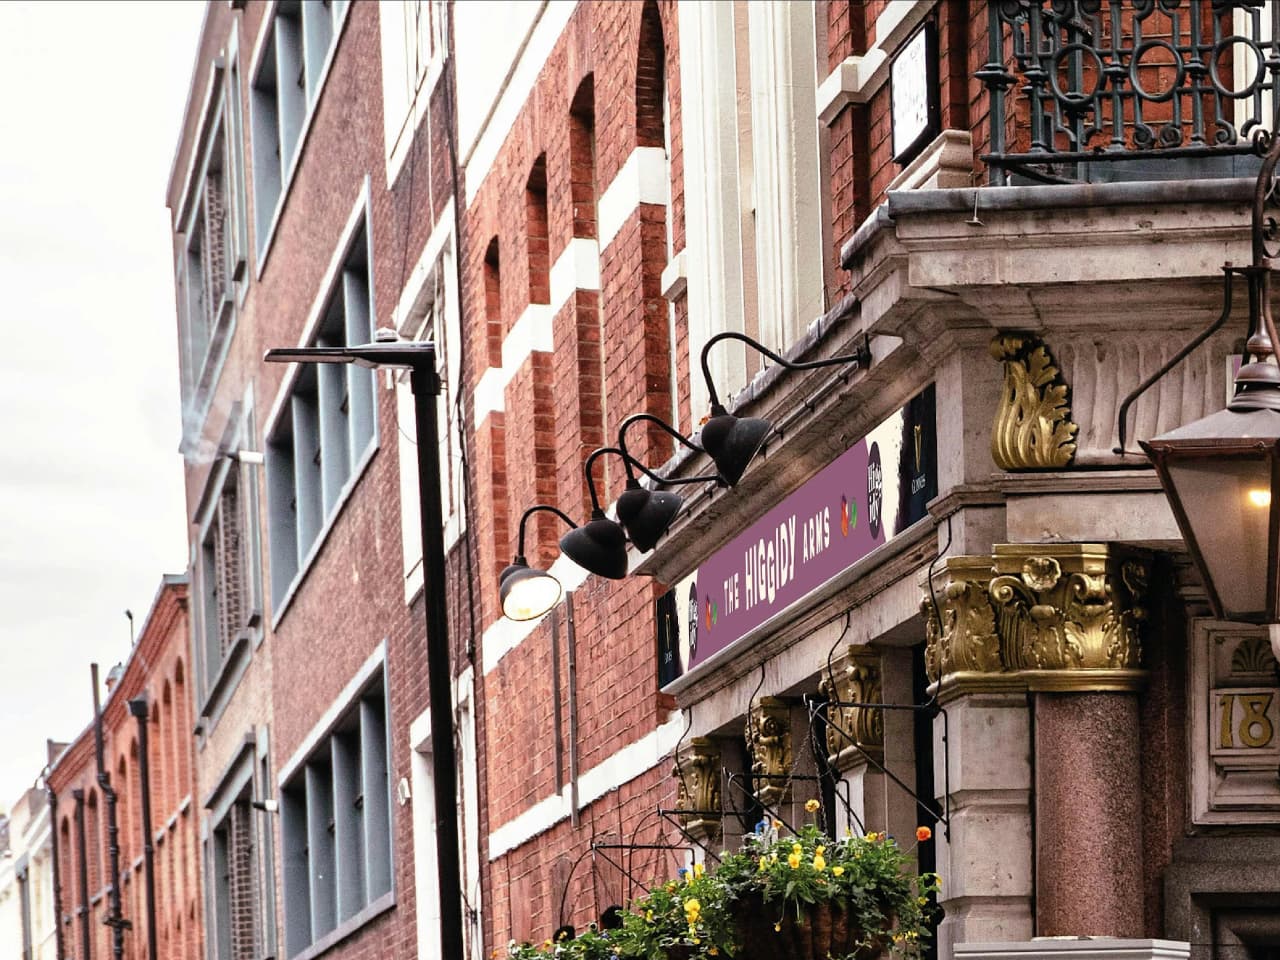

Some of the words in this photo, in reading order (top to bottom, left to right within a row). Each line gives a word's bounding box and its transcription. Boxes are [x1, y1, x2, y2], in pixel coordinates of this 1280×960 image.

[723, 572, 740, 617] THE
[745, 514, 797, 611] HIGGIDY
[803, 506, 831, 564] ARMS
[1217, 692, 1273, 748] 18
